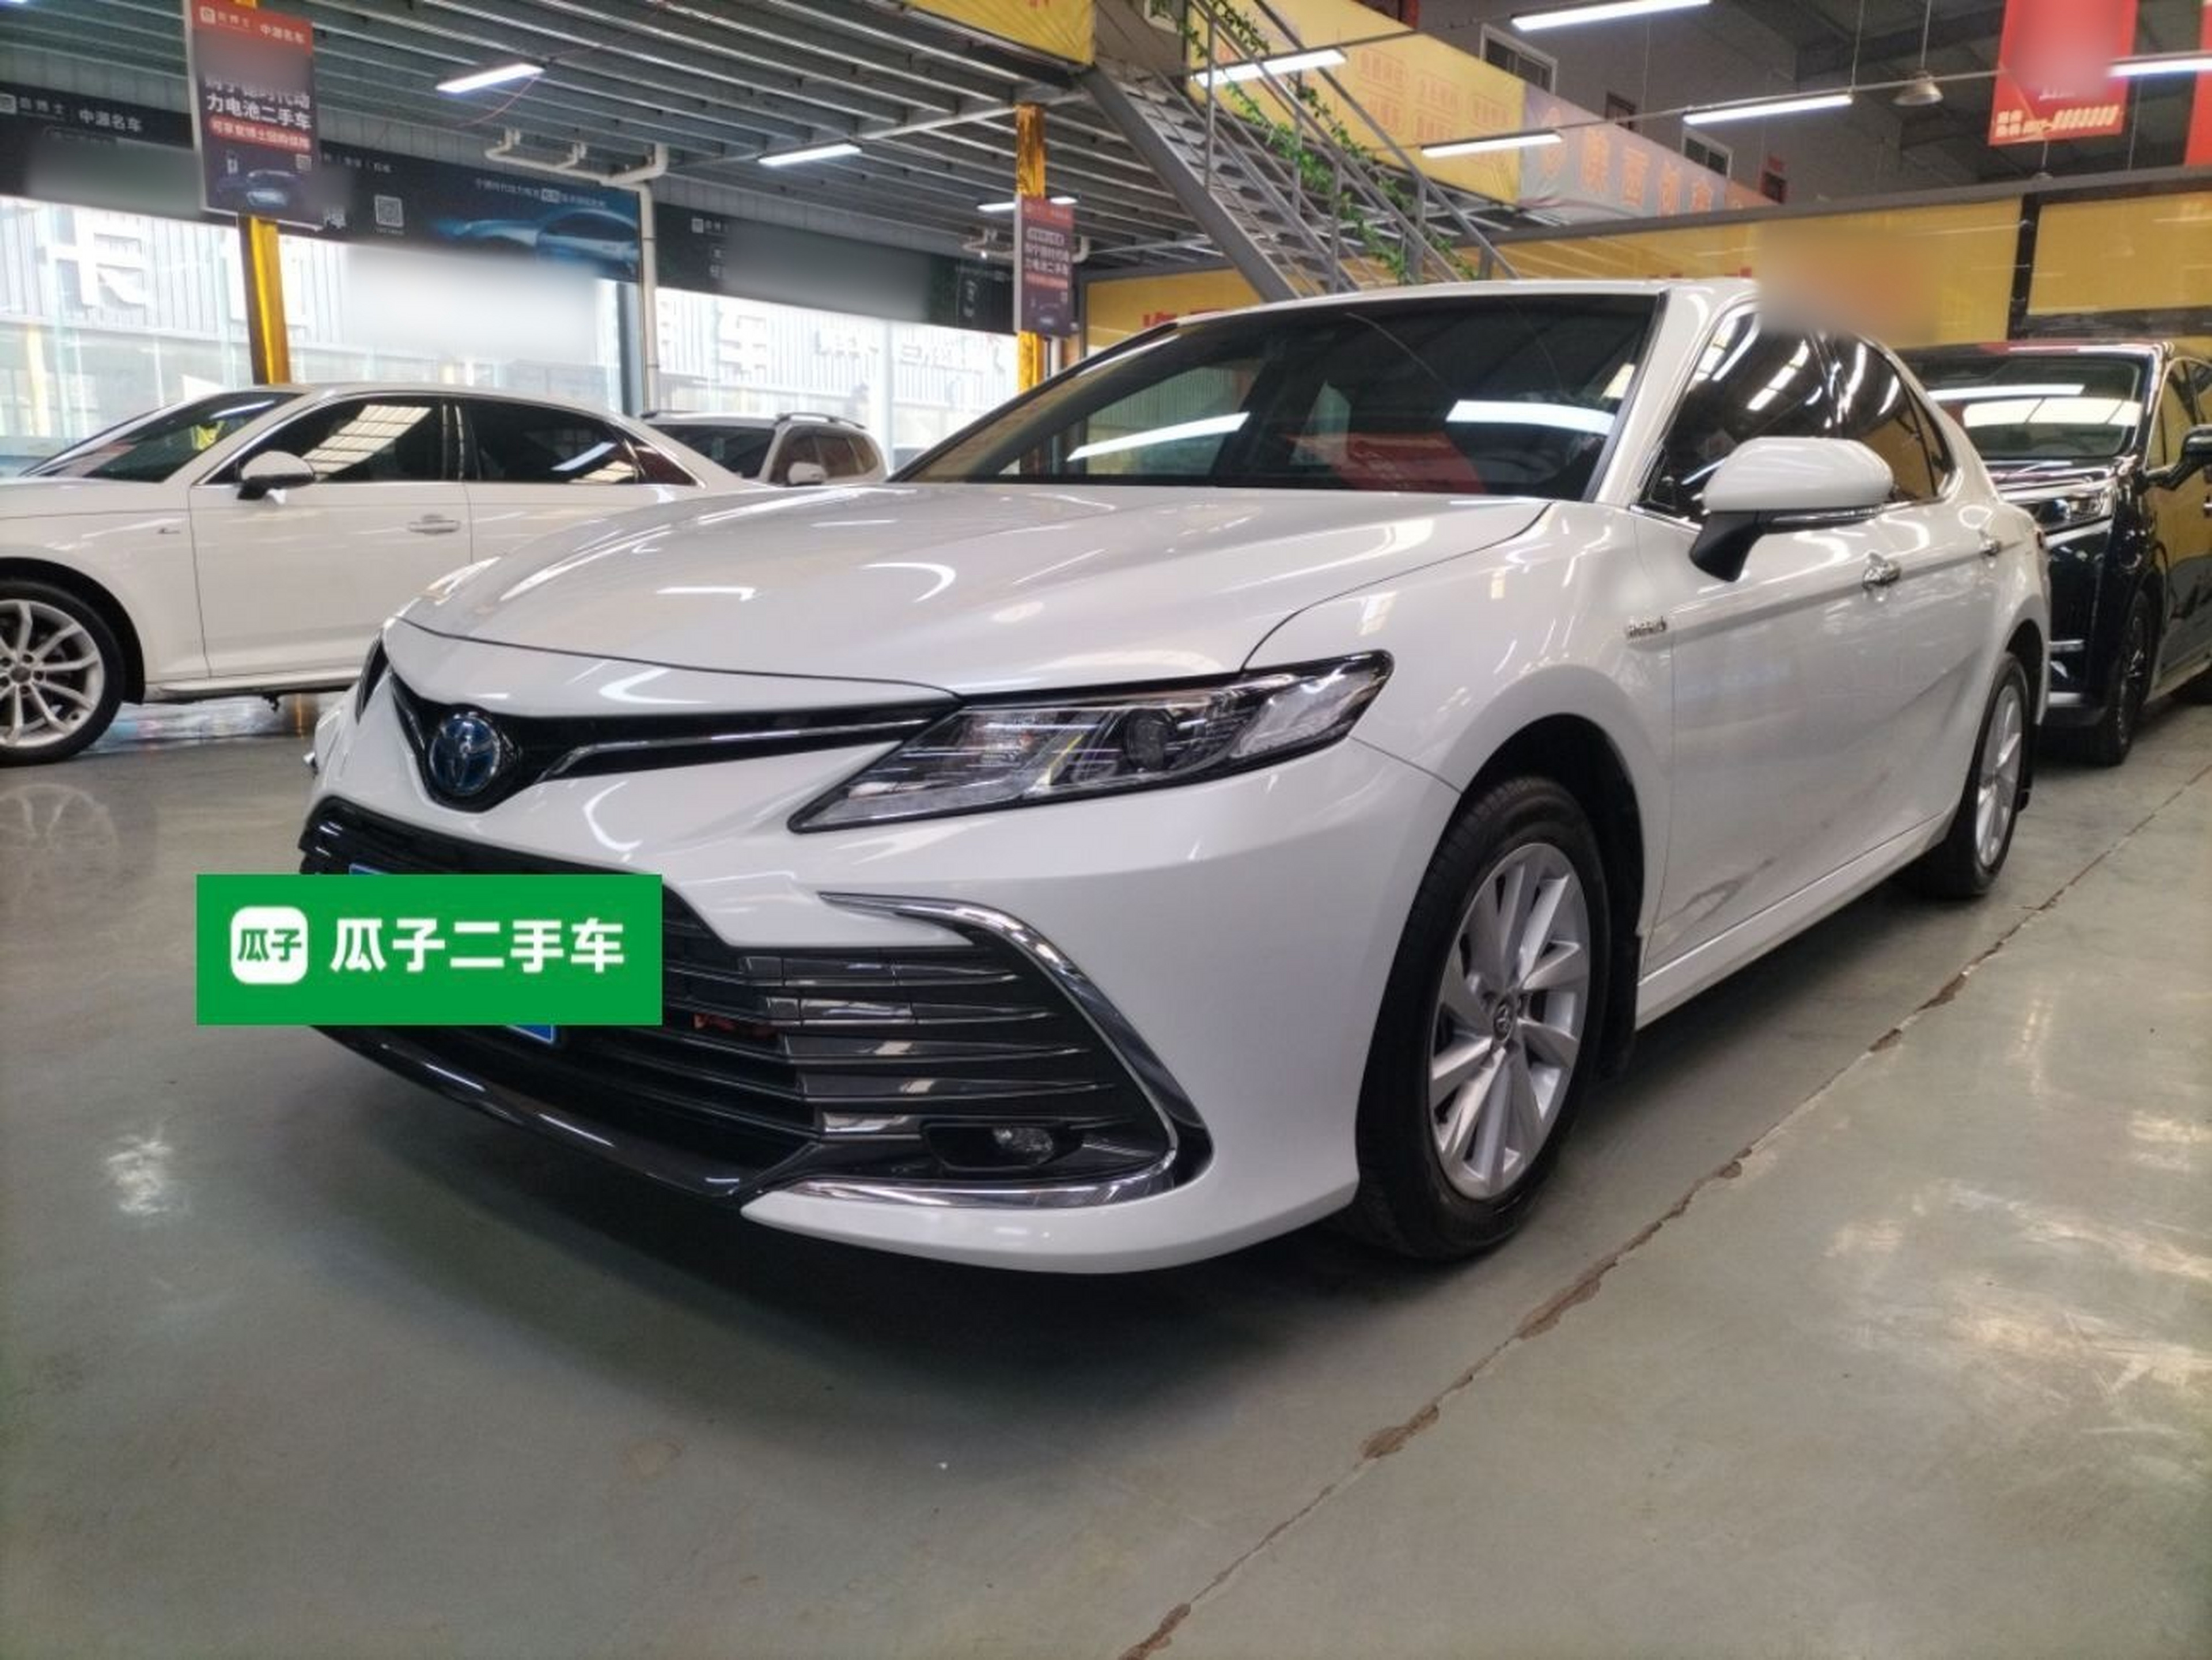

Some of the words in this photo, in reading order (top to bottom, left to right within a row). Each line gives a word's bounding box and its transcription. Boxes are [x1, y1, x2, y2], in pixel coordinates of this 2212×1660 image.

[206, 93, 312, 131] 力电池二手车
